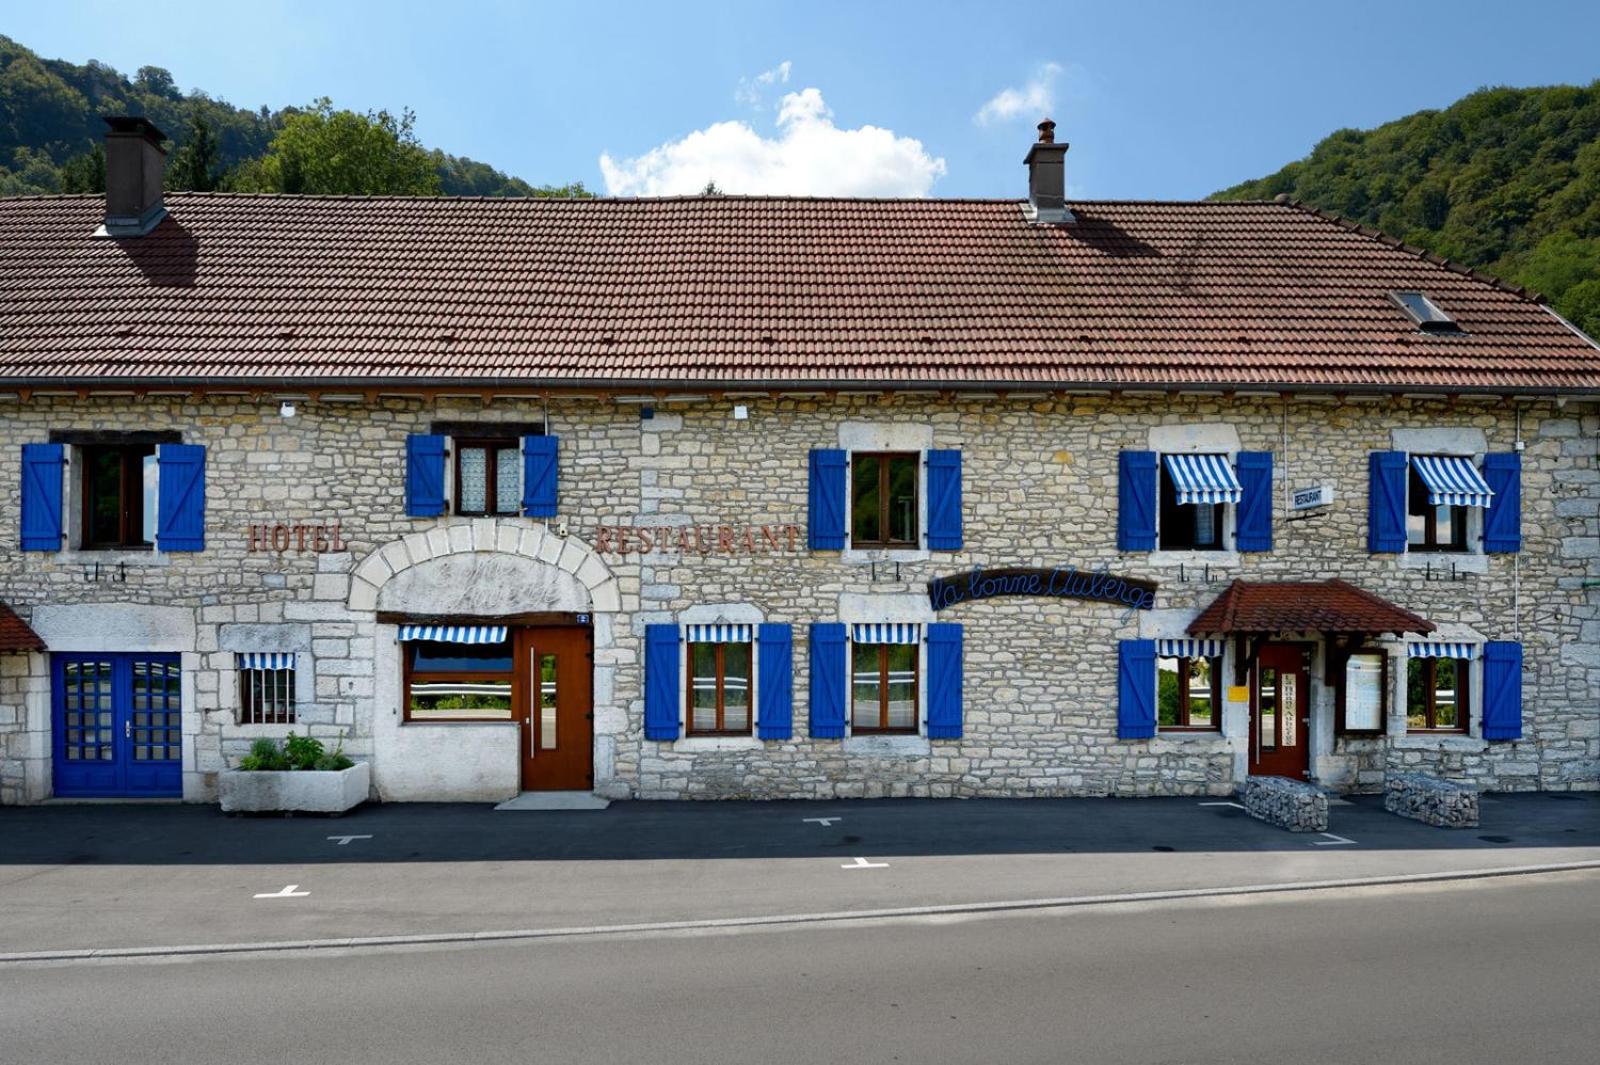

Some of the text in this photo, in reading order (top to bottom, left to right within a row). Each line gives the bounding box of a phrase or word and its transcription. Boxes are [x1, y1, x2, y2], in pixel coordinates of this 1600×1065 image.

[1295, 490, 1322, 506] RESTAURANT
[596, 525, 801, 554] RESTAURANT
[1045, 564, 1155, 625] Auberge
